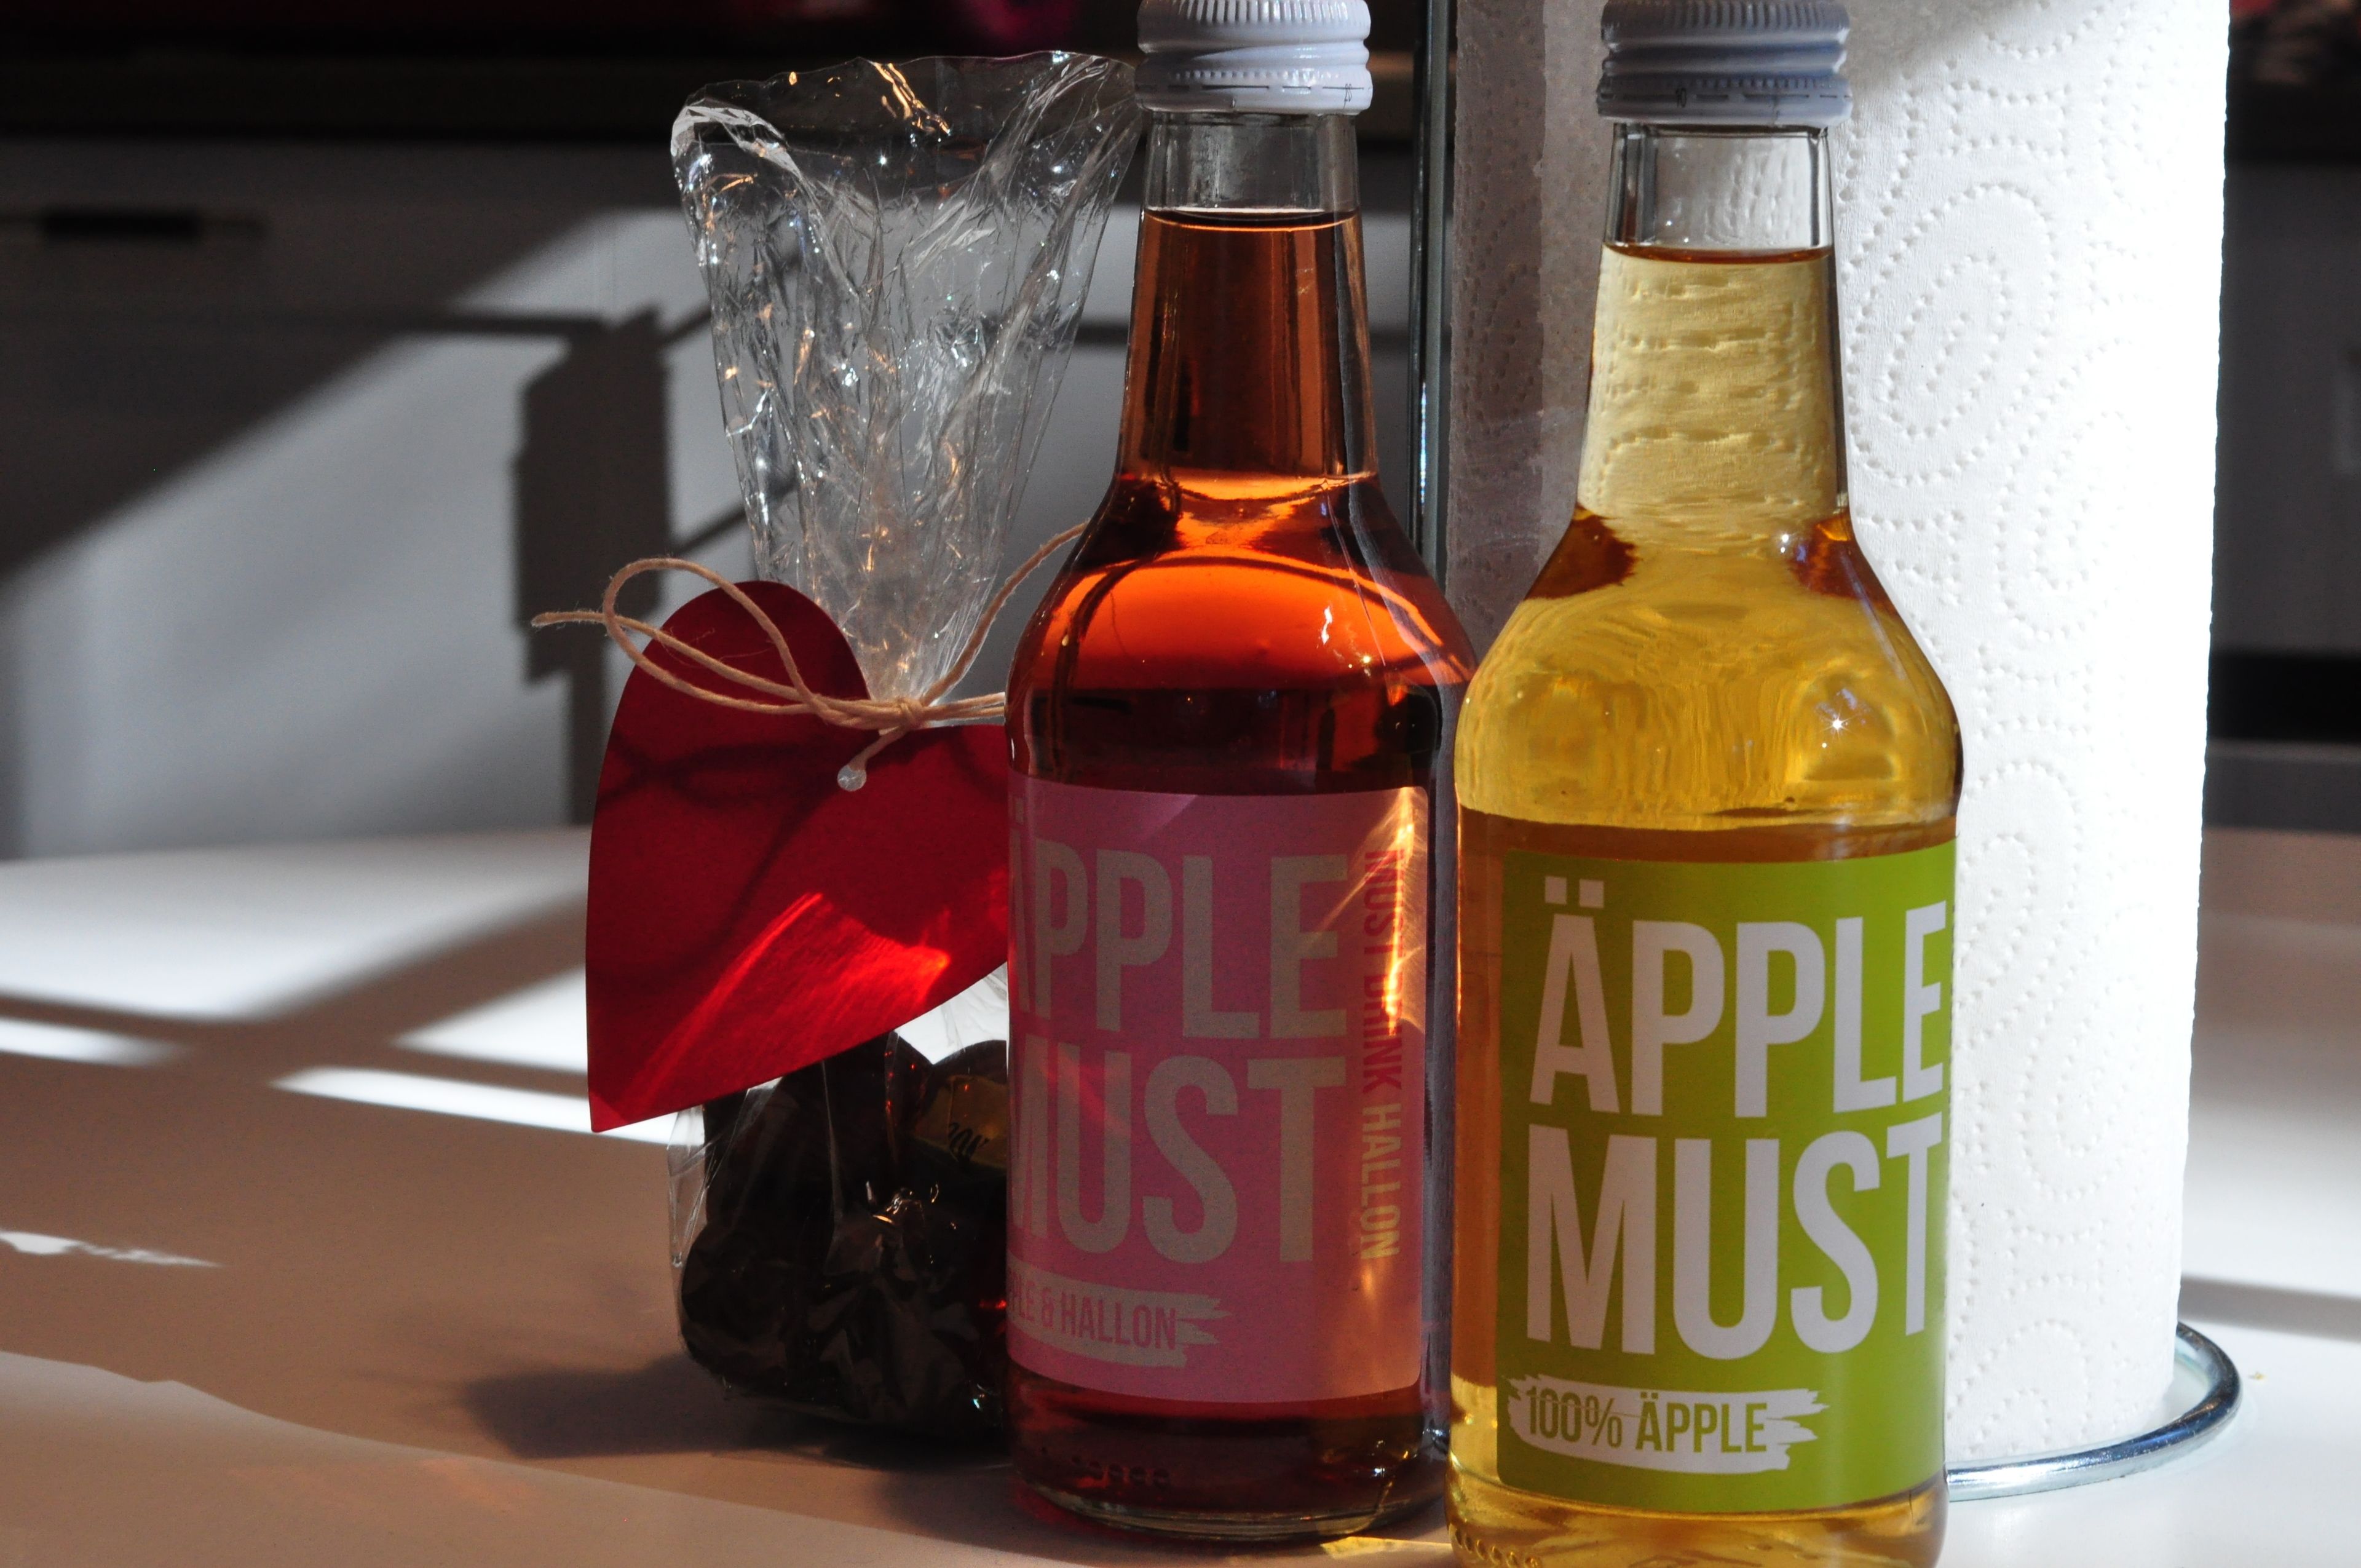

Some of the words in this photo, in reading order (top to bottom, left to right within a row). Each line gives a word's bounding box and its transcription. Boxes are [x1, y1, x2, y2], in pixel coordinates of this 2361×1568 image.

[1363, 849, 1405, 957] MUST
[1362, 973, 1404, 1094] DRINK
[1529, 875, 1947, 1118] ÄPPLE
[1360, 1103, 1402, 1260] HALLON
[1527, 1111, 1943, 1360] MUST
[1007, 1267, 1035, 1322] PLE
[1041, 1286, 1054, 1328] &
[1061, 1291, 1177, 1350] HALLON
[1525, 1385, 1622, 1448] 100%
[1635, 1391, 1768, 1454] ÄPPLE
